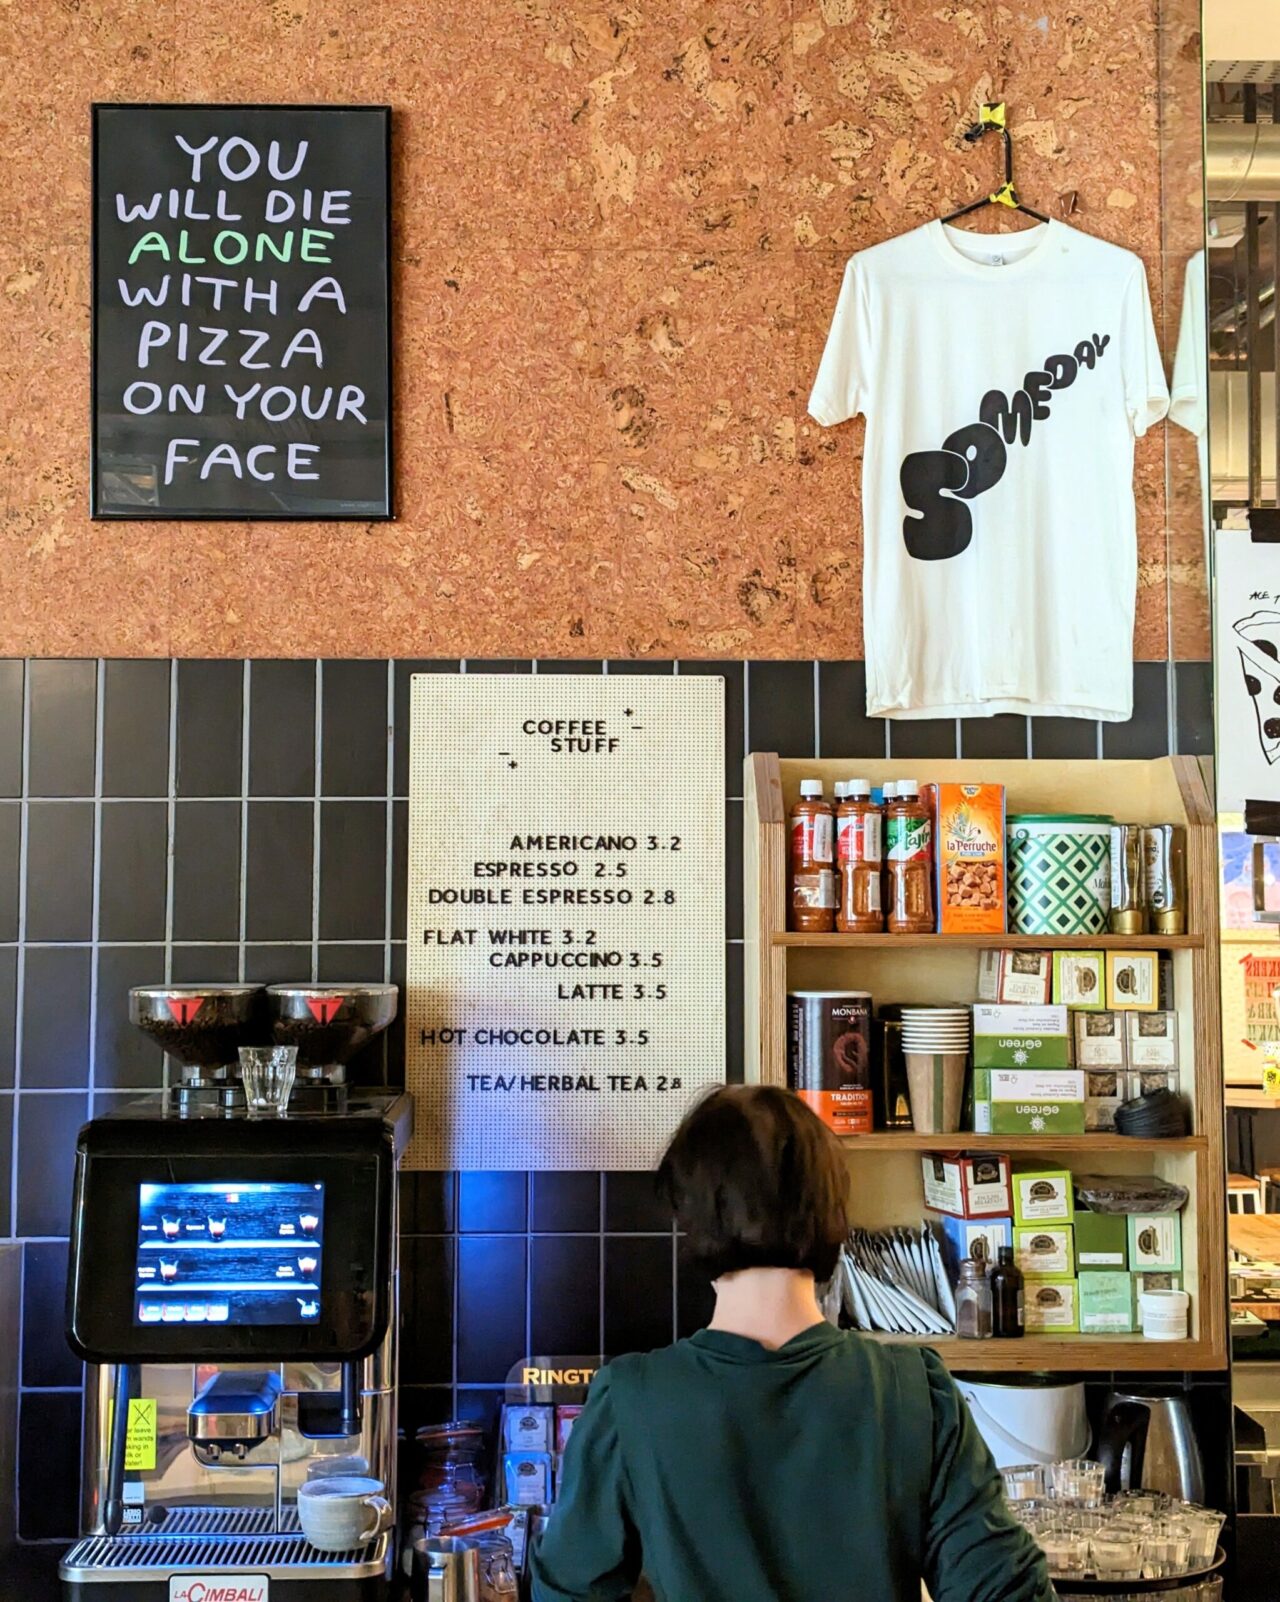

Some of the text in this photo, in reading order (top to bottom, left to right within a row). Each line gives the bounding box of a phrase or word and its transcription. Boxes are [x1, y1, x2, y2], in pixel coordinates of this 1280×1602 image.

[175, 135, 308, 182] YOU
[116, 189, 352, 224] WILL DIE
[127, 228, 335, 265] ALONE
[118, 273, 347, 315] WITH A
[138, 320, 323, 368] PIZZA
[122, 381, 368, 424] ON YOUR
[900, 333, 1111, 561] SOMEDAY
[165, 439, 321, 485] FACE
[522, 720, 606, 735] COFFEE
[551, 738, 620, 753] STUFF
[510, 835, 681, 851] AMERICANO 3.2
[947, 840, 996, 852] la Perruche
[474, 861, 627, 877] ESPRESSO 2.5
[428, 889, 675, 904] DOUBLE ESPRESSO 2.8
[423, 930, 597, 945] FLAT WHITE 3.2
[489, 952, 662, 967] CAPPUCCINO 3.5
[558, 984, 666, 1000] LATTE 3.5
[832, 1008, 868, 1016] MONBANA
[421, 1029, 648, 1046] HOT CHOCOLATE 3.5
[999, 1039, 1042, 1049] eGreen
[607, 1075, 648, 1091] TEA
[1016, 1105, 1059, 1115] eGreen
[522, 1367, 598, 1385] RINGT
[187, 1582, 264, 1602] CIMBALI
